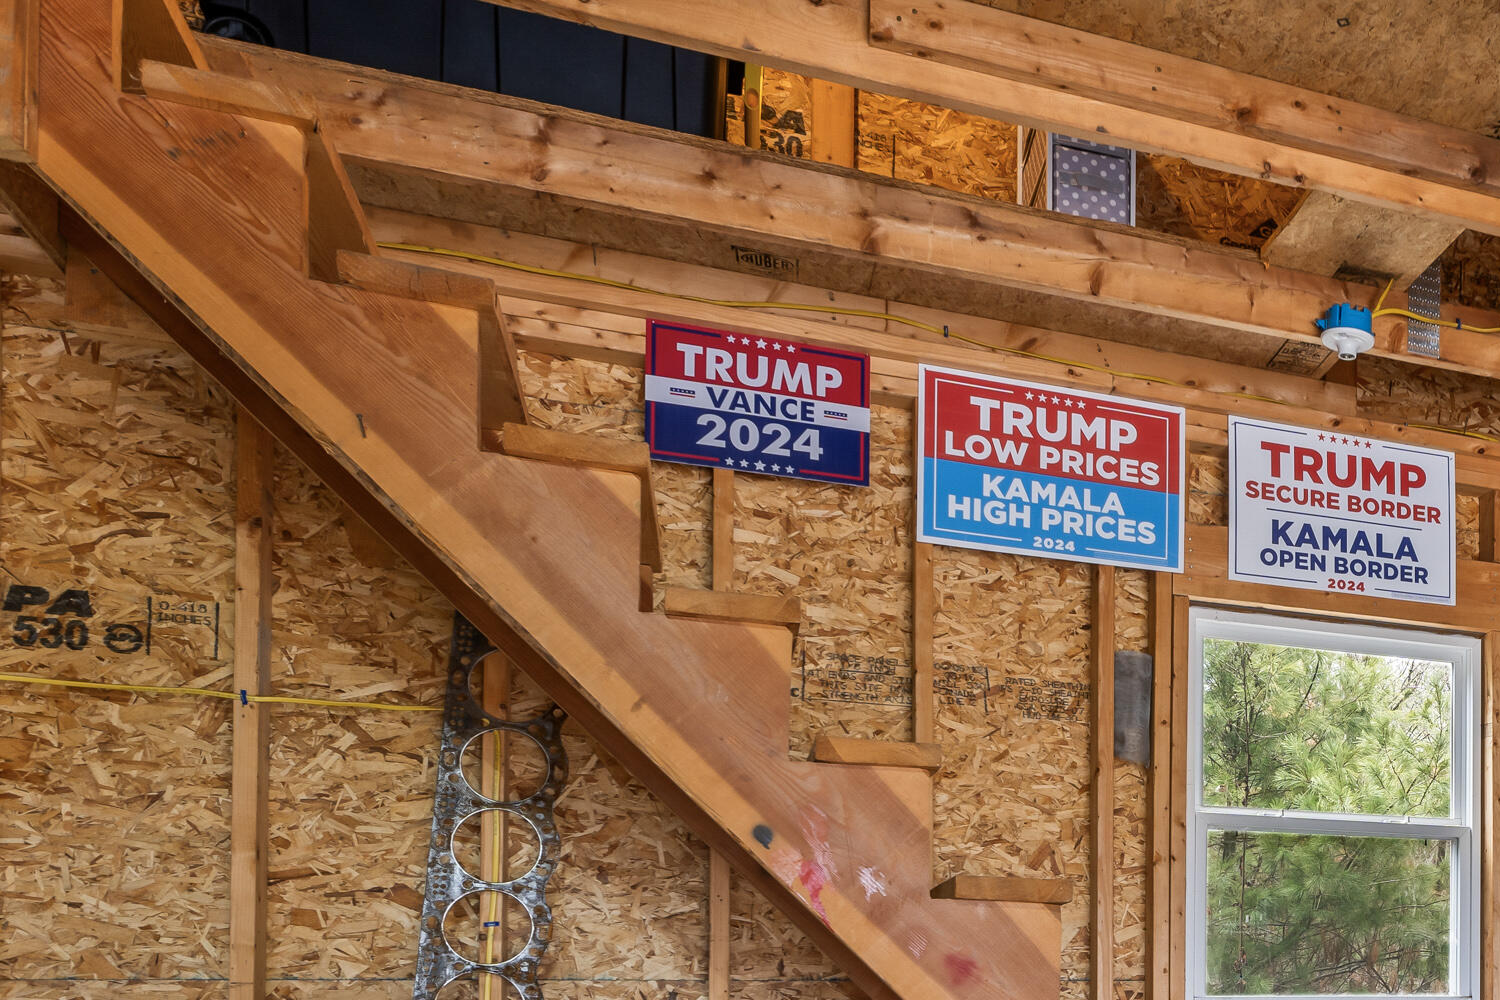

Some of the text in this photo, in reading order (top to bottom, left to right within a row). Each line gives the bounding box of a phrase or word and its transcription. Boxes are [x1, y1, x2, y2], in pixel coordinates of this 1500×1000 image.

[676, 342, 843, 398] TRUMP
[705, 386, 815, 422] VANCE
[970, 395, 1138, 452] TRUMP
[696, 413, 823, 461] 2024
[945, 430, 1160, 486] LOW PRICES
[1260, 441, 1427, 497] TRUMP
[982, 473, 1125, 516] KAMALA
[1245, 480, 1441, 524] SECURE BORDER
[948, 494, 1156, 545] HIGH PRICES
[1271, 519, 1419, 562] KAMALA
[1033, 536, 1075, 552] 2024
[1260, 548, 1429, 585] OPEN BORDER
[1327, 578, 1366, 592] 2024
[12, 615, 88, 650] 530
[157, 614, 212, 626] INCHES
